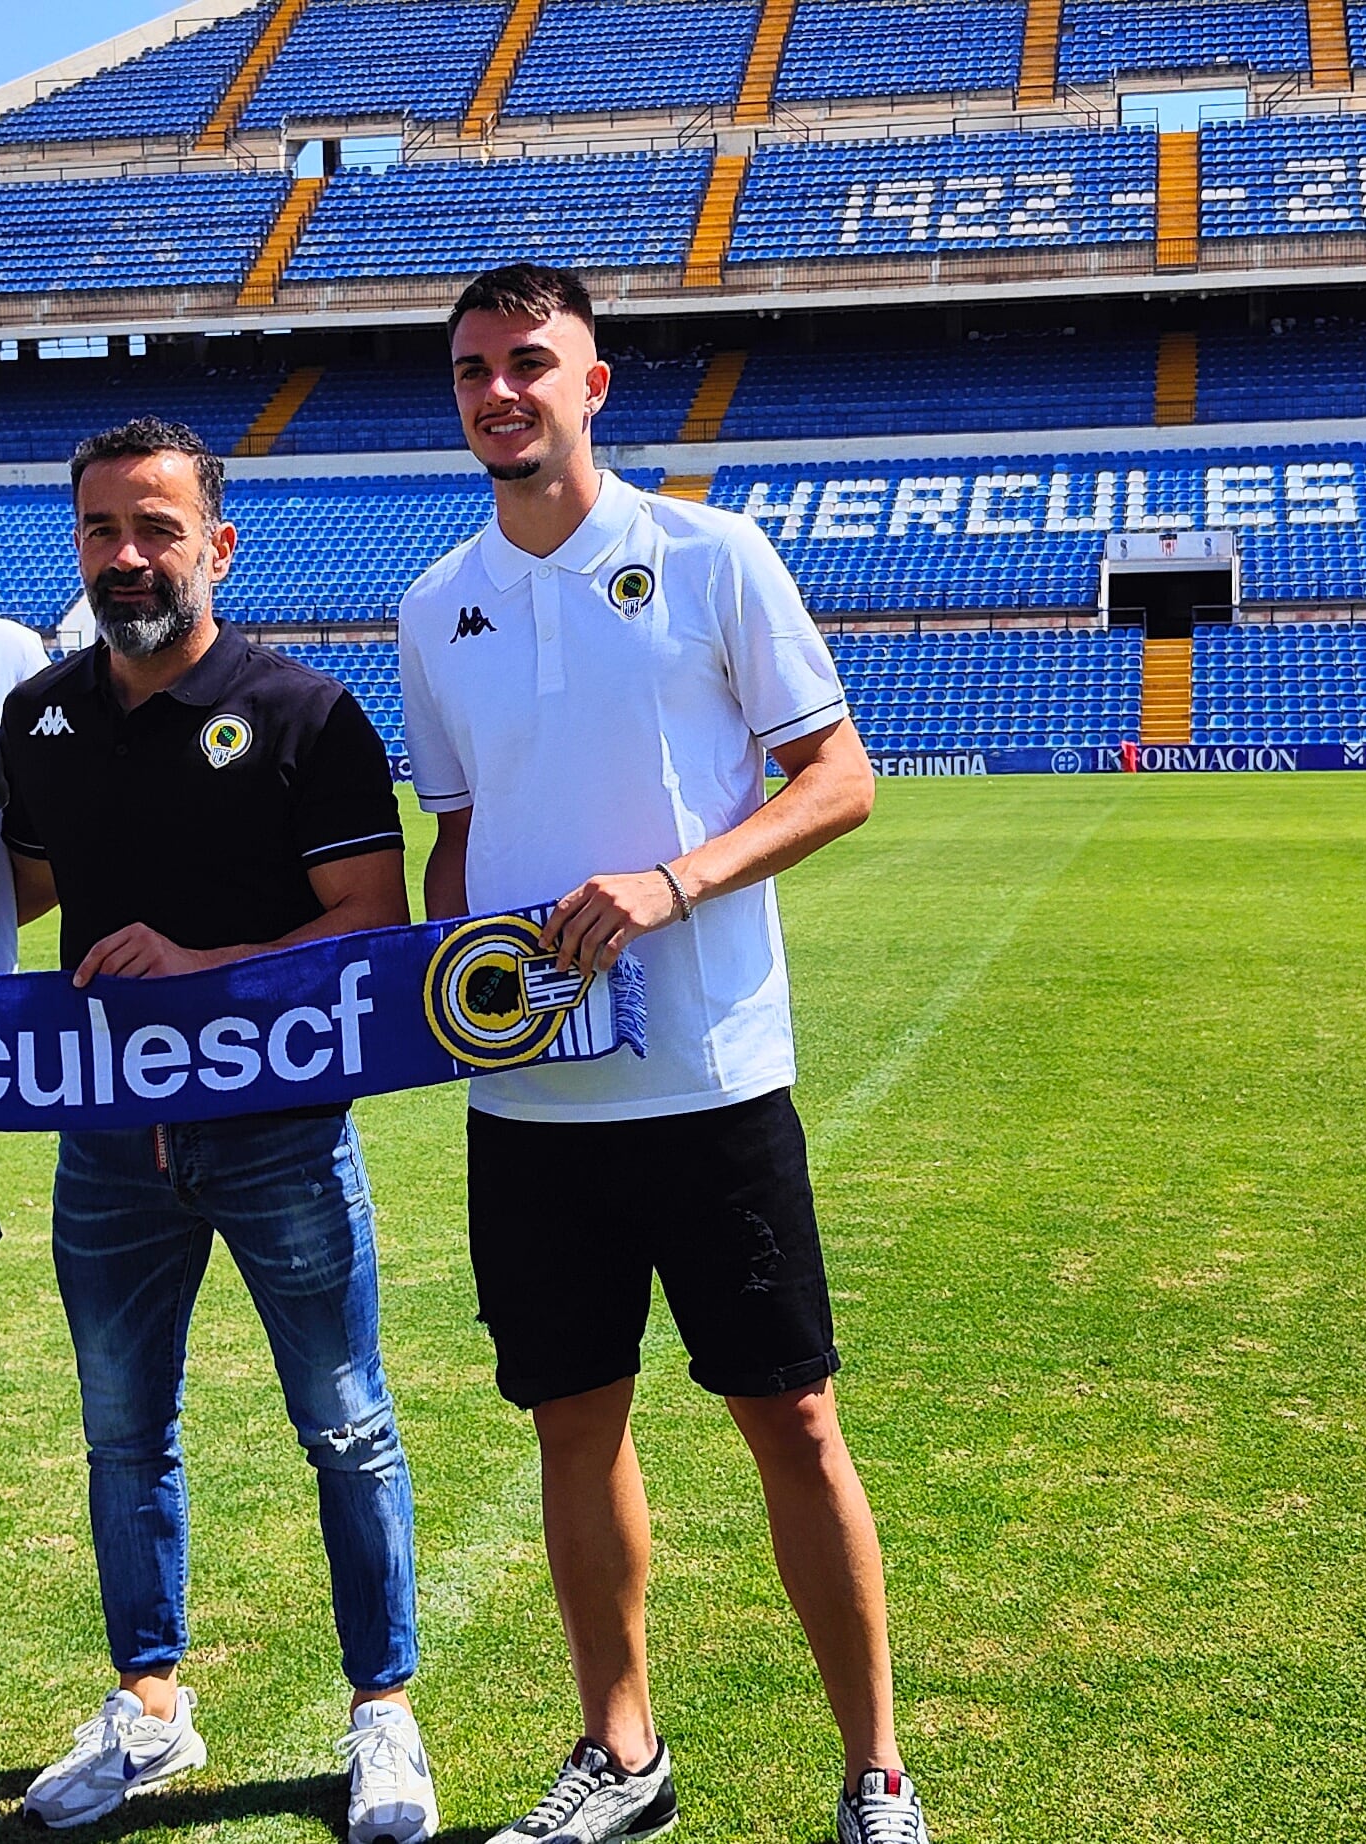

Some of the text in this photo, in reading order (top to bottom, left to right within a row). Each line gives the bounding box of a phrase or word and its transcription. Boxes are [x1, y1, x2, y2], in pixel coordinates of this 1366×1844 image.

[841, 171, 1072, 244] 1922
[744, 462, 1356, 538] HERCULES
[870, 754, 987, 776] SEGUNDA
